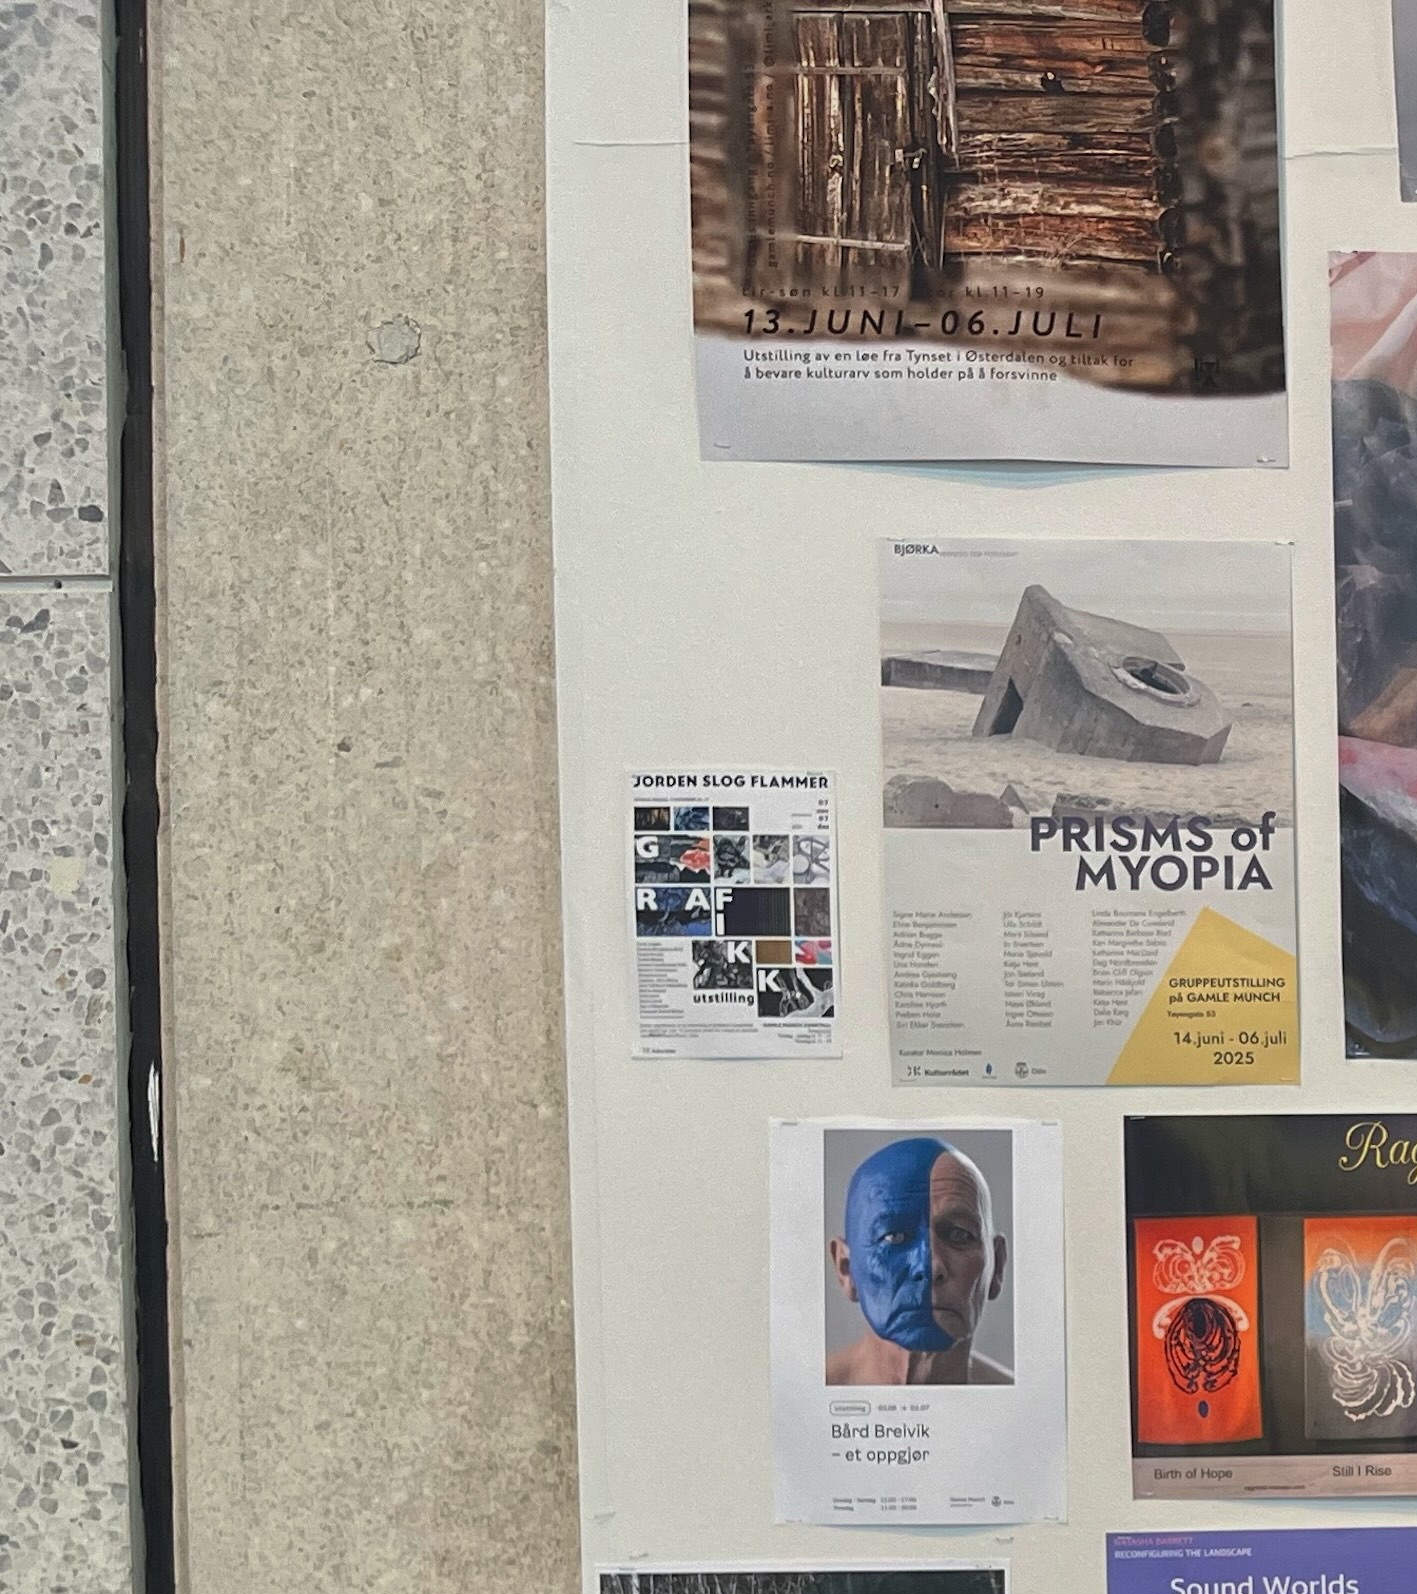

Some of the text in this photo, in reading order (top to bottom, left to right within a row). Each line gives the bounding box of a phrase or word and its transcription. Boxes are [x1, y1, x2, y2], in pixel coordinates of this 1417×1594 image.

[756, 368, 801, 380] bevare
[806, 367, 870, 380] kulturarv
[874, 371, 903, 379] som
[908, 368, 952, 380] holder
[958, 368, 974, 383] på
[991, 369, 1057, 381] forsvinne
[894, 544, 938, 556] BJØRKA
[633, 775, 828, 789] JORDEN SLOG FLAMMER
[1030, 812, 1276, 851] PRISMS of
[1076, 856, 1273, 891] MYOPIA
[1169, 977, 1285, 989] GRUPPEUTSTILLING
[692, 992, 754, 1006] utstilling
[1169, 991, 1280, 1005] på GAMLE MUNCH
[832, 1424, 929, 1438] Bård Breivik
[1154, 1468, 1232, 1482] Birth of Hope
